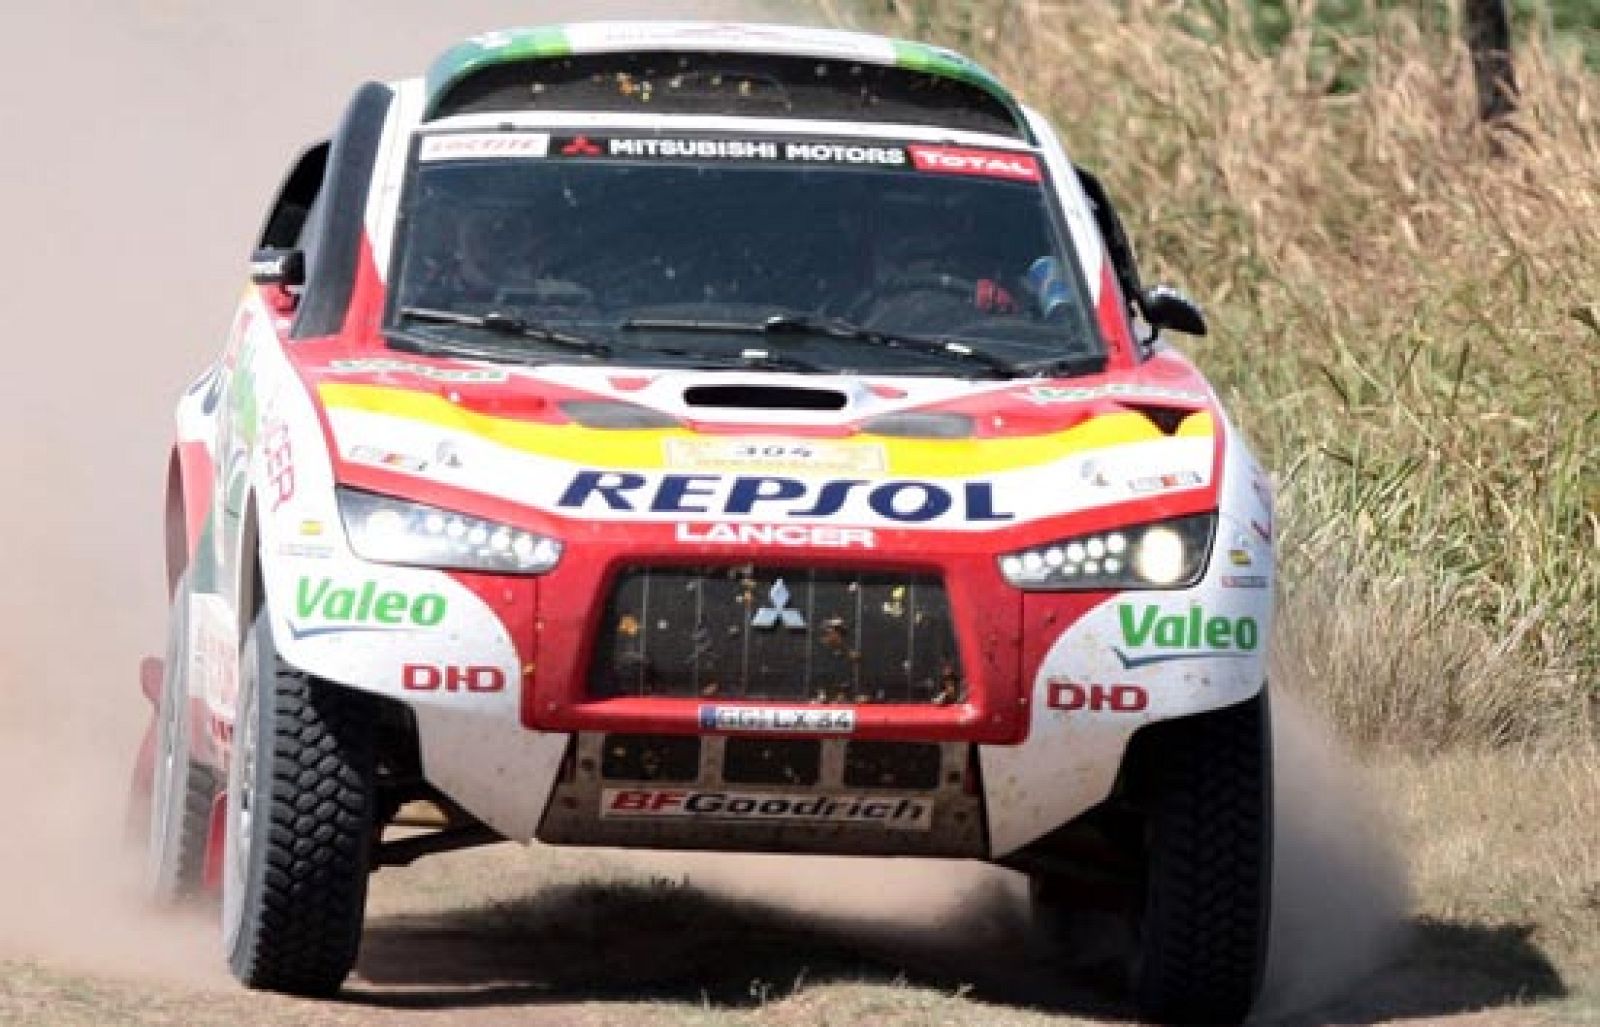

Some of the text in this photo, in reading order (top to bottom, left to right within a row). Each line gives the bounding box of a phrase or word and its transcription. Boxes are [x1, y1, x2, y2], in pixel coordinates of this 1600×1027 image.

[610, 139, 906, 163] MITSUBISHI MOTORS
[914, 150, 1034, 176] TOTAL
[557, 470, 1016, 521] REPSOL
[676, 522, 876, 548] LANCER
[295, 576, 448, 627] Valeo
[1119, 603, 1258, 650] Valeo
[611, 791, 925, 821] BFGoodrich
